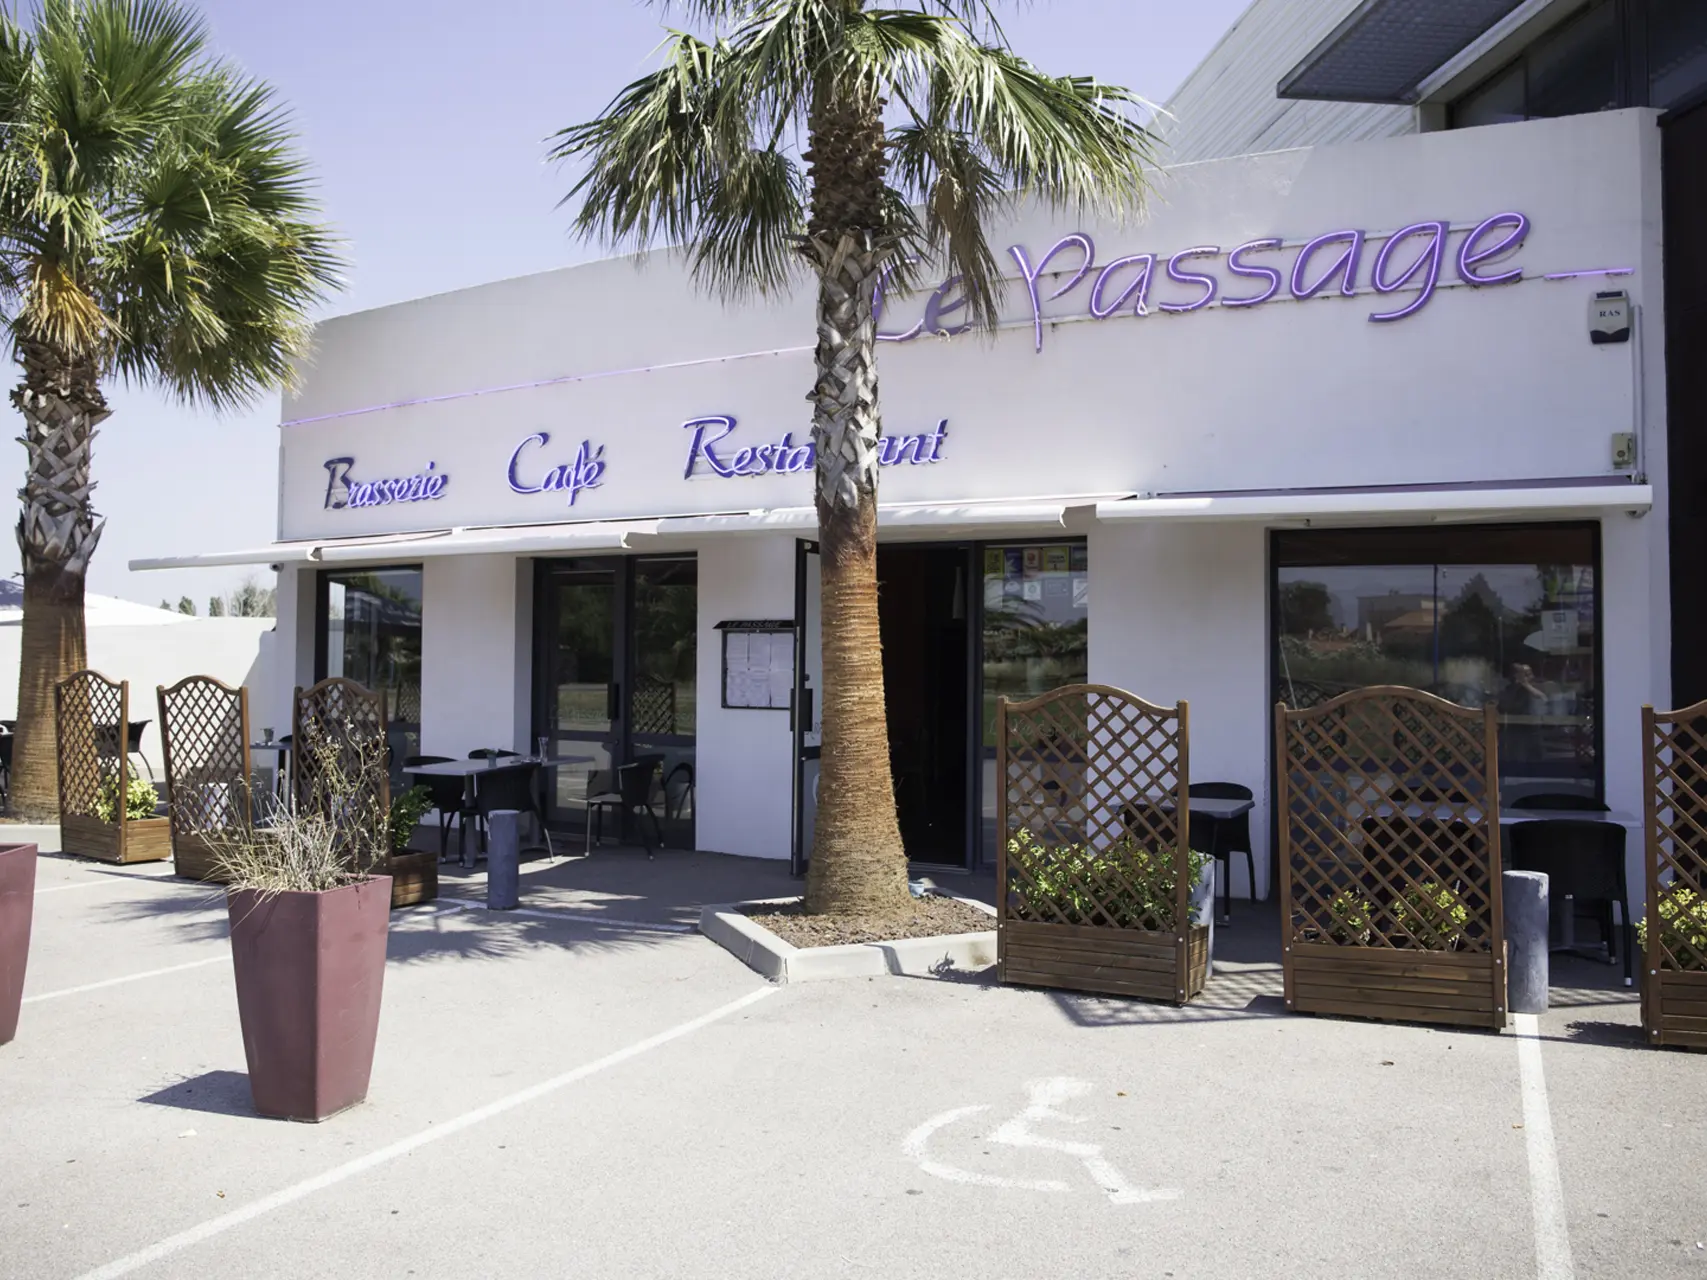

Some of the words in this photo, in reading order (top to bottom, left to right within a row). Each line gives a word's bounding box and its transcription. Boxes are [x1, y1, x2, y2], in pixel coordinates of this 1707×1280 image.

[1007, 212, 1531, 353] Passage
[1599, 309, 1621, 317] RAS
[323, 456, 449, 510] Brasserie
[507, 432, 606, 506] Café
[682, 415, 949, 480] Restaant
